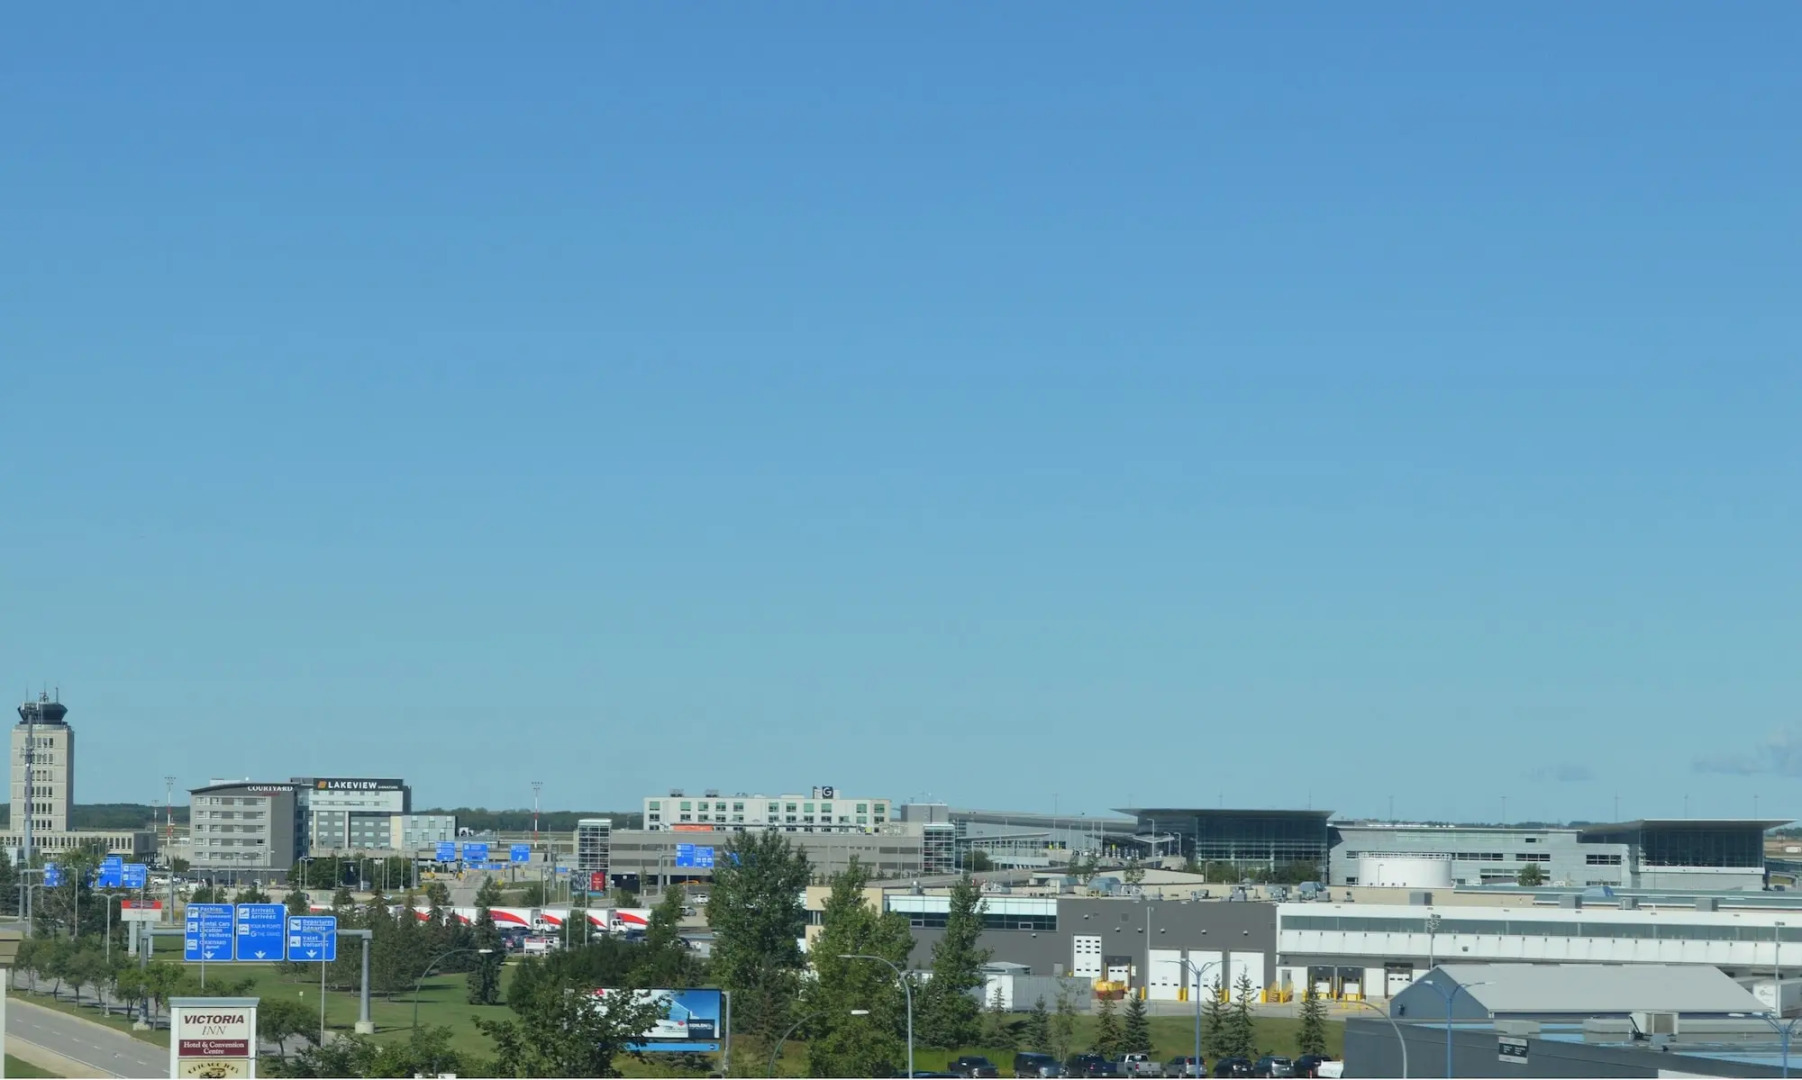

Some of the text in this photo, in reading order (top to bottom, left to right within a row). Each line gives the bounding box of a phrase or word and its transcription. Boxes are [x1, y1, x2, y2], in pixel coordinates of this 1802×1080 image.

[328, 781, 377, 789] LAKEVIEW
[823, 787, 832, 797] G
[184, 1015, 245, 1024] VICTORIA
[202, 1026, 226, 1035] INN
